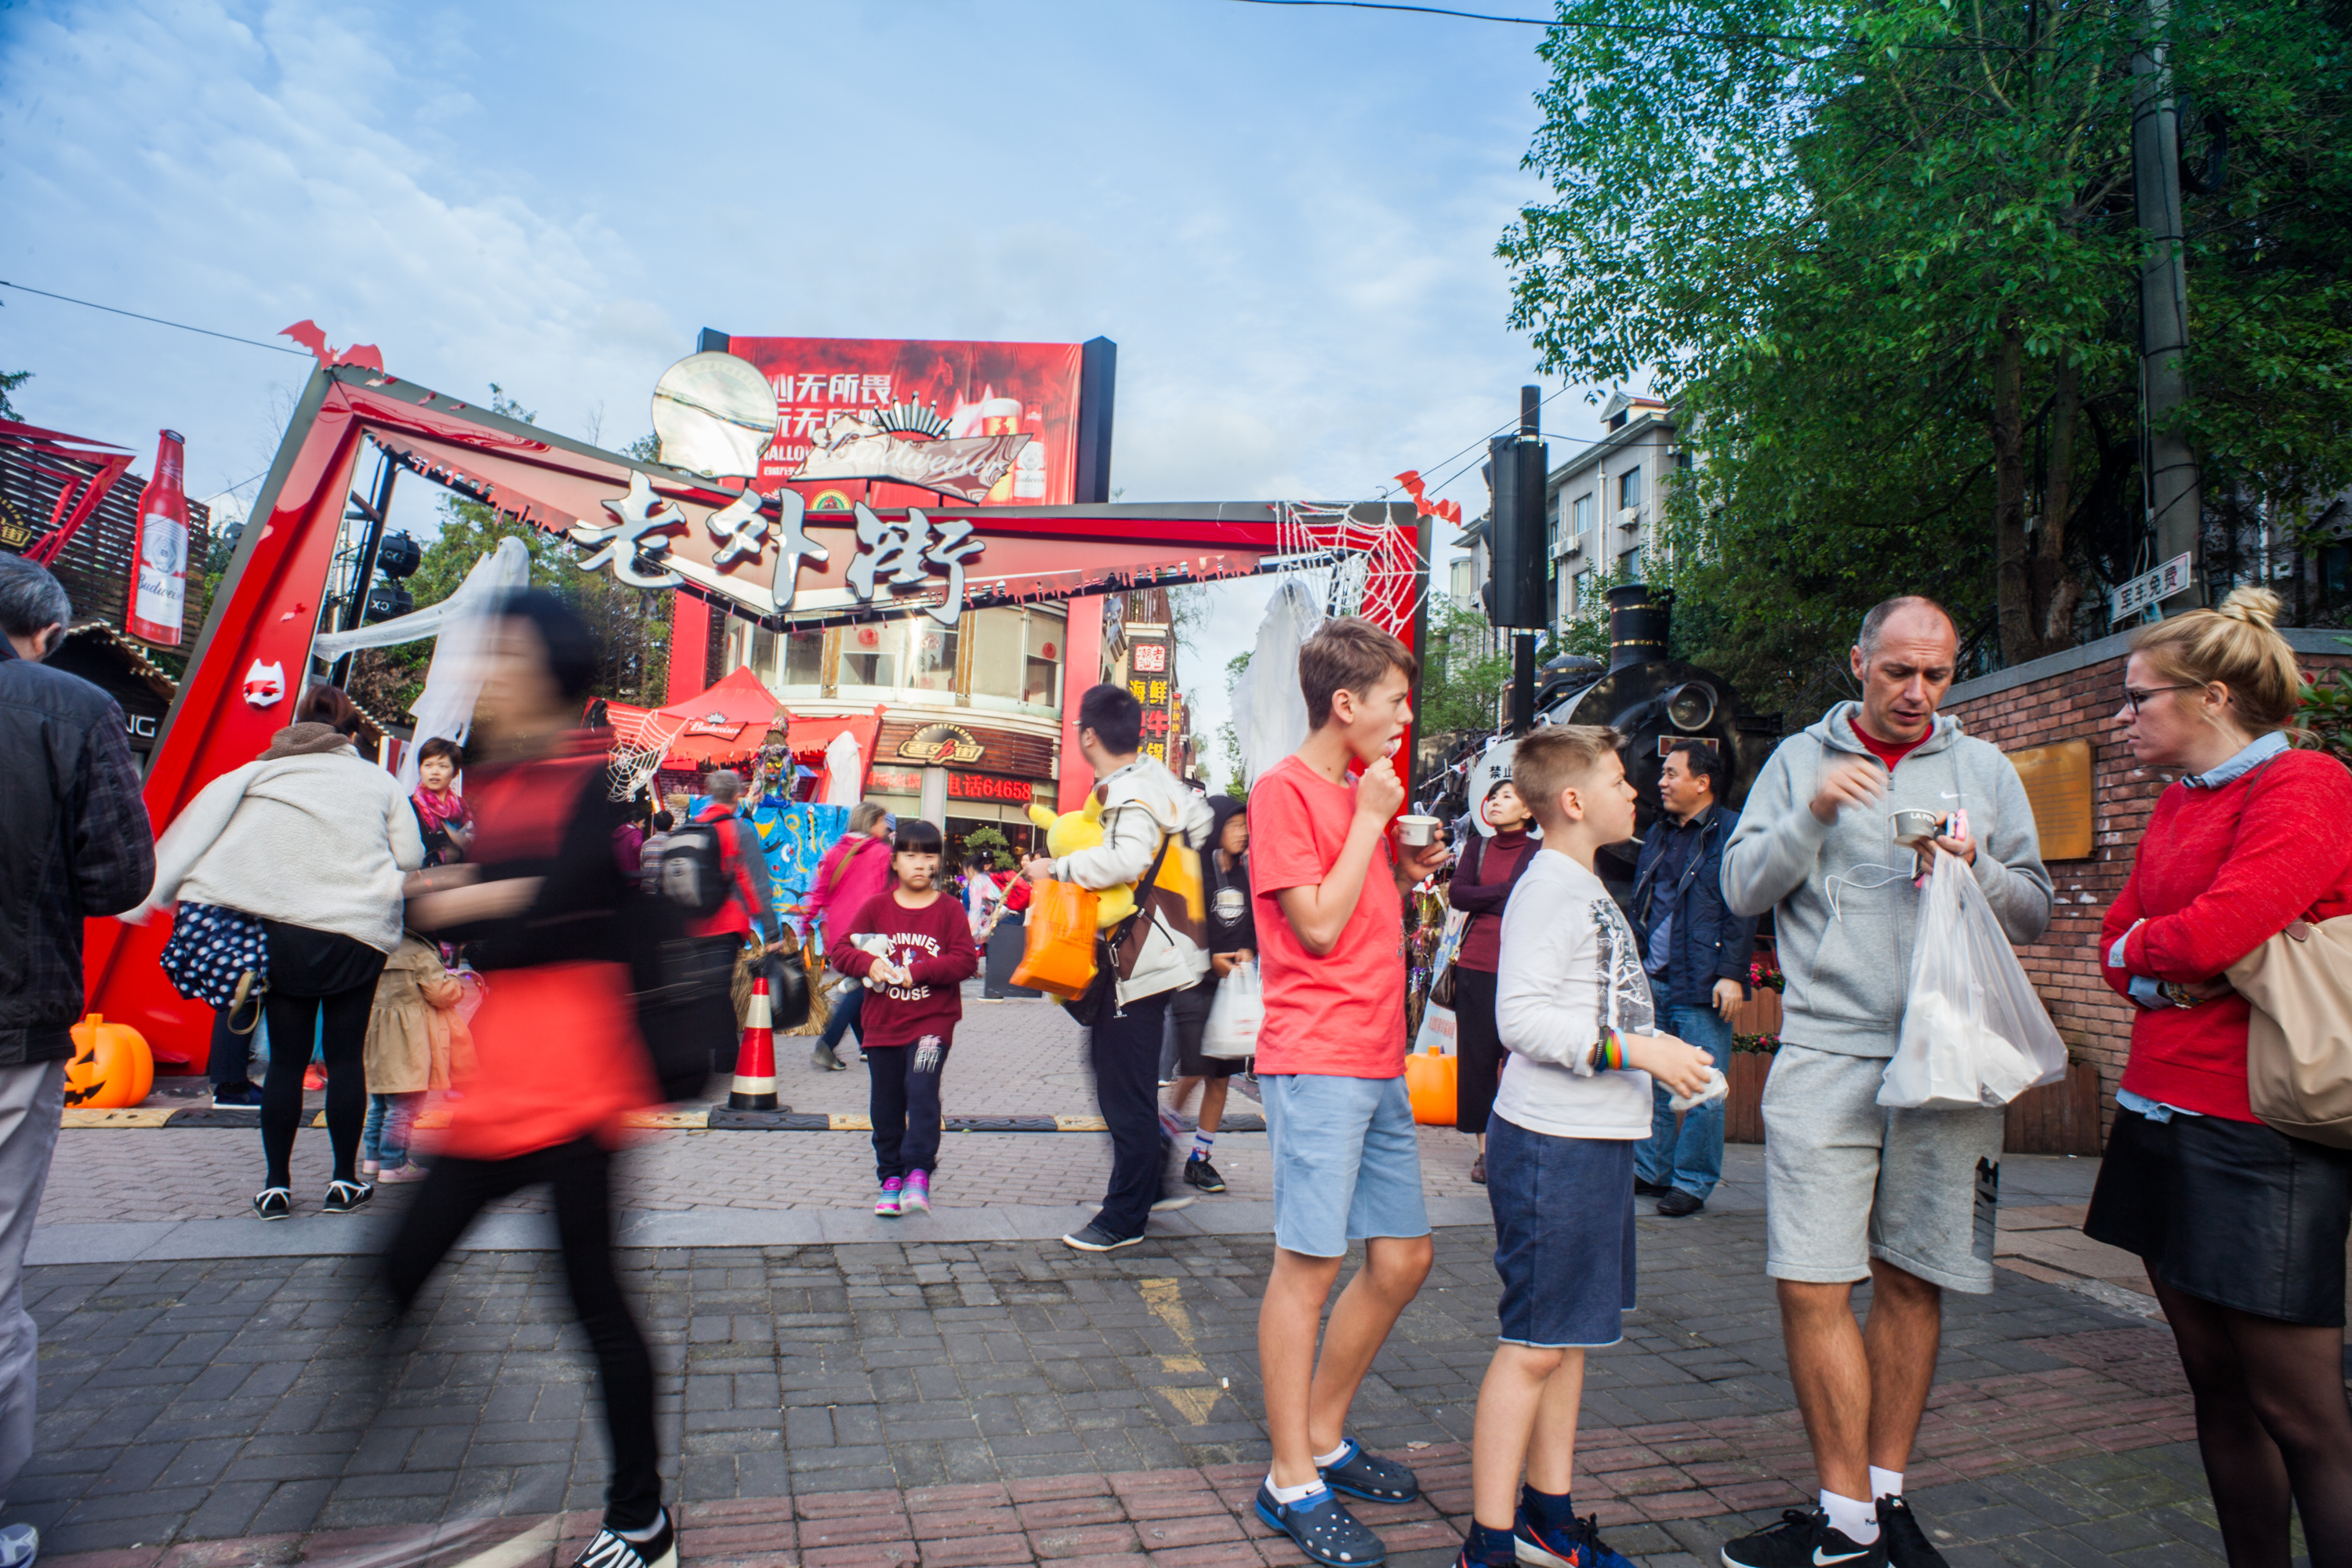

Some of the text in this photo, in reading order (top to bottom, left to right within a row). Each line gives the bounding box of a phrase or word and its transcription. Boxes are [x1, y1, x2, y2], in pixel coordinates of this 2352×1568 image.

[0, 496, 24, 526] ERING
[568, 470, 986, 625] 老外街
[2121, 565, 2177, 610] 军车免费
[1129, 680, 1167, 706] 海鲜
[689, 721, 742, 735] Budweiser
[913, 723, 976, 746] OUR GATHERING
[1139, 710, 1170, 738] 牛
[1138, 742, 1164, 763] 锅
[1489, 764, 1512, 779] 禁止
[948, 773, 1032, 801] 电话64658
[887, 985, 931, 1001] OUSE
